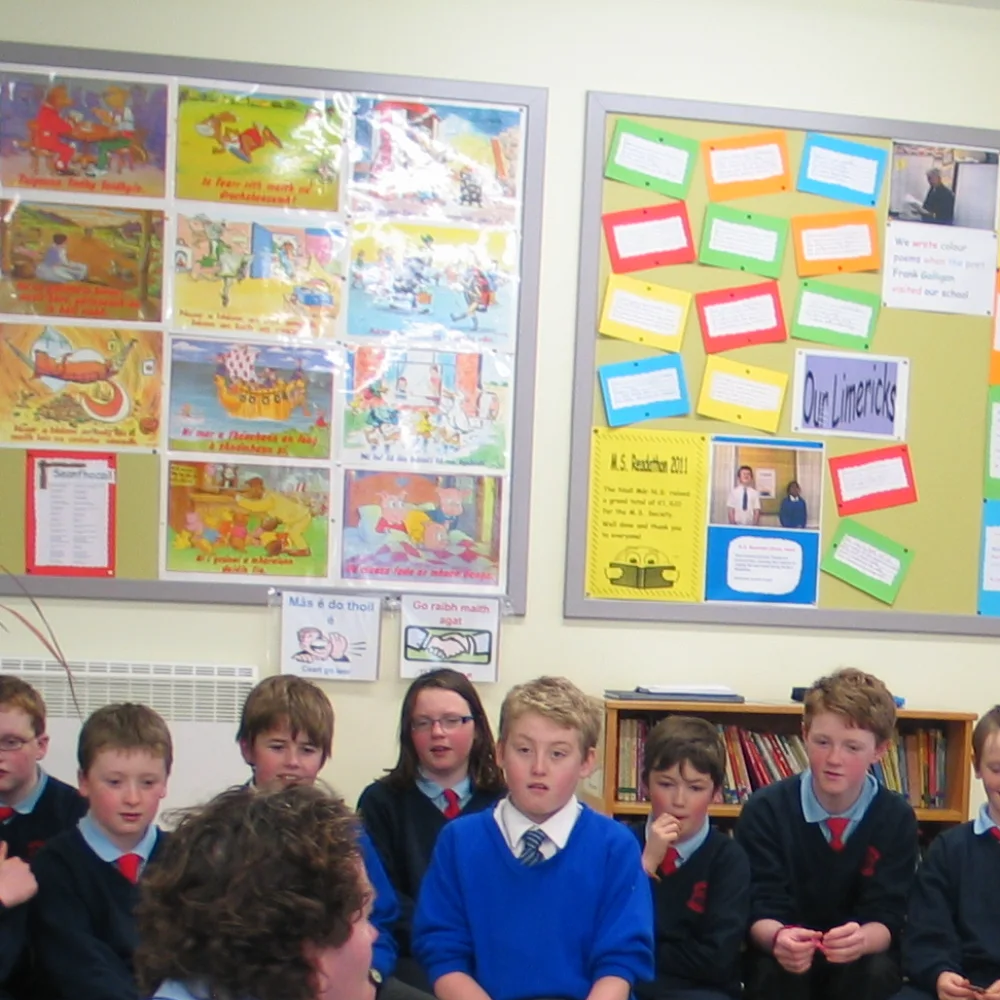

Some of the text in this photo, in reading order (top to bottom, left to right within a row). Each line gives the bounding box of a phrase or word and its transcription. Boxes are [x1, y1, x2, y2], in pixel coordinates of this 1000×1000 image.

[895, 238, 967, 252] We wrote colour
[893, 254, 921, 264] poems
[893, 268, 918, 278] Frank
[942, 290, 969, 300] school
[803, 362, 897, 428] Our Limericks
[670, 455, 688, 474] 2011
[289, 596, 374, 612] Más é do thoil
[413, 600, 490, 613] Go raibh maith
[327, 616, 334, 625] é
[440, 616, 462, 626] agat
